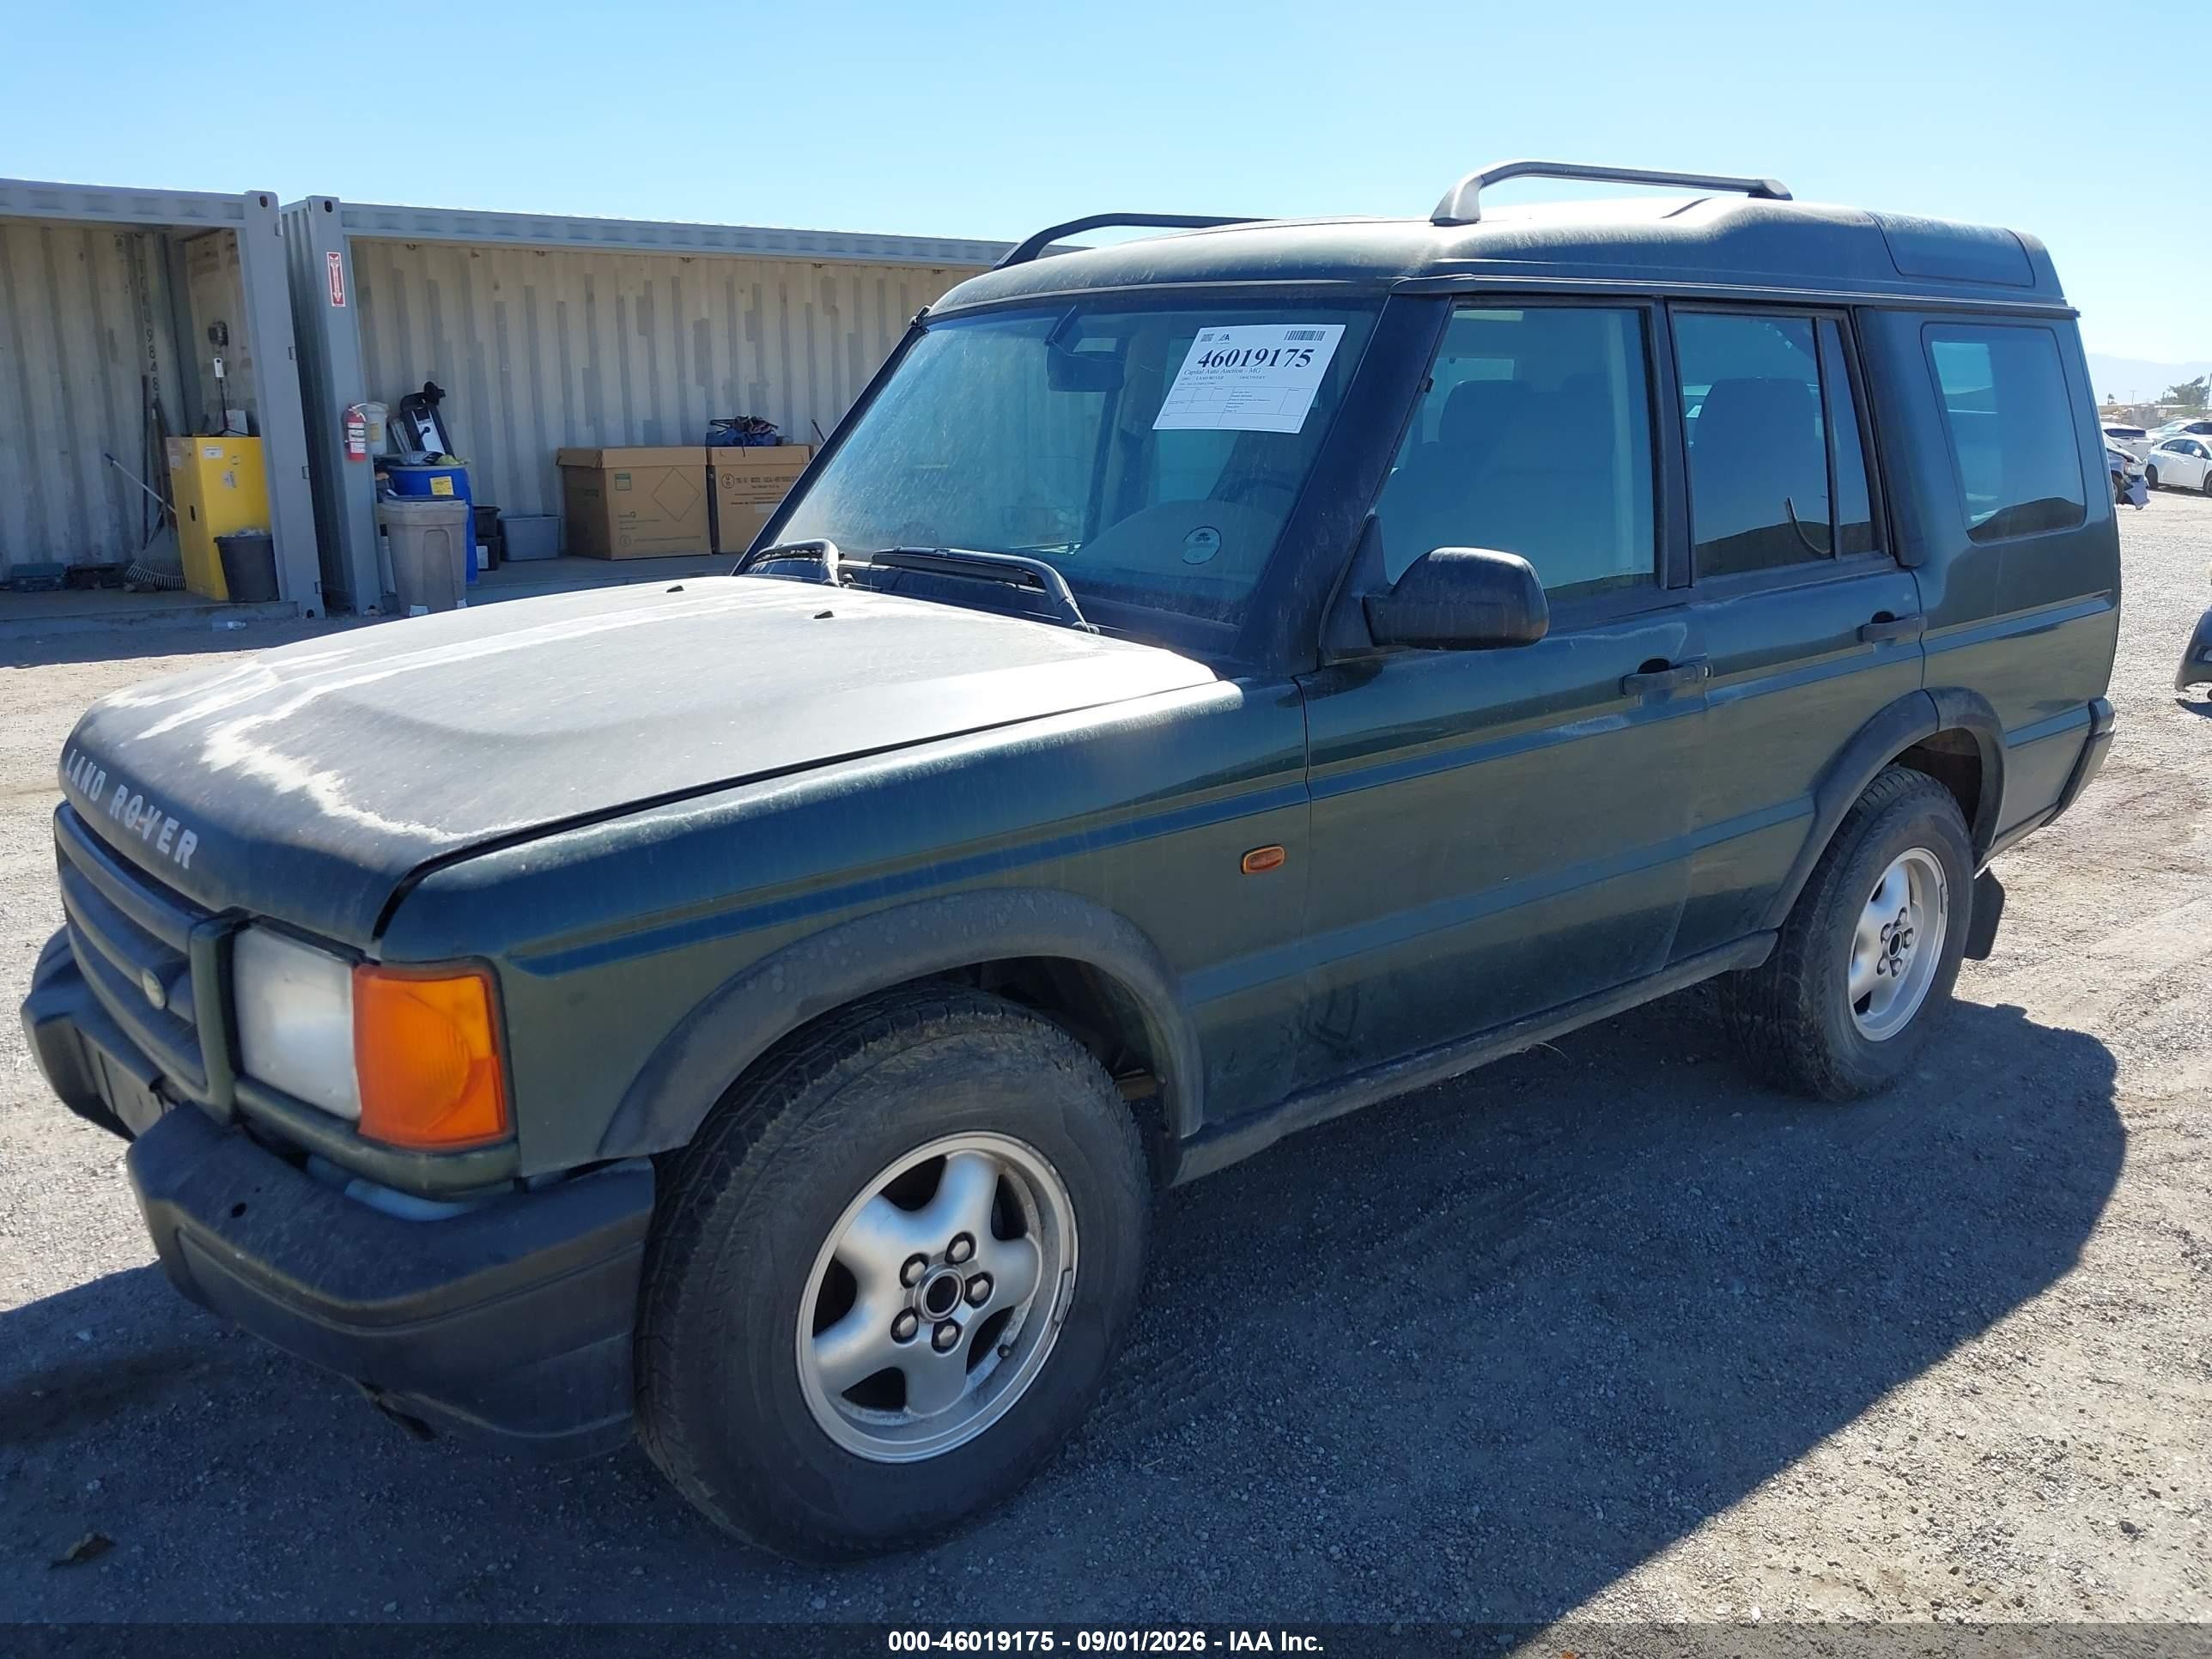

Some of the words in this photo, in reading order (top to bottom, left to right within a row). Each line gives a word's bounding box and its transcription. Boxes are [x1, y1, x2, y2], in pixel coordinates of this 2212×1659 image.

[1197, 347, 1316, 368] 46019175
[66, 749, 106, 802] LAND
[110, 784, 198, 870] ROVER
